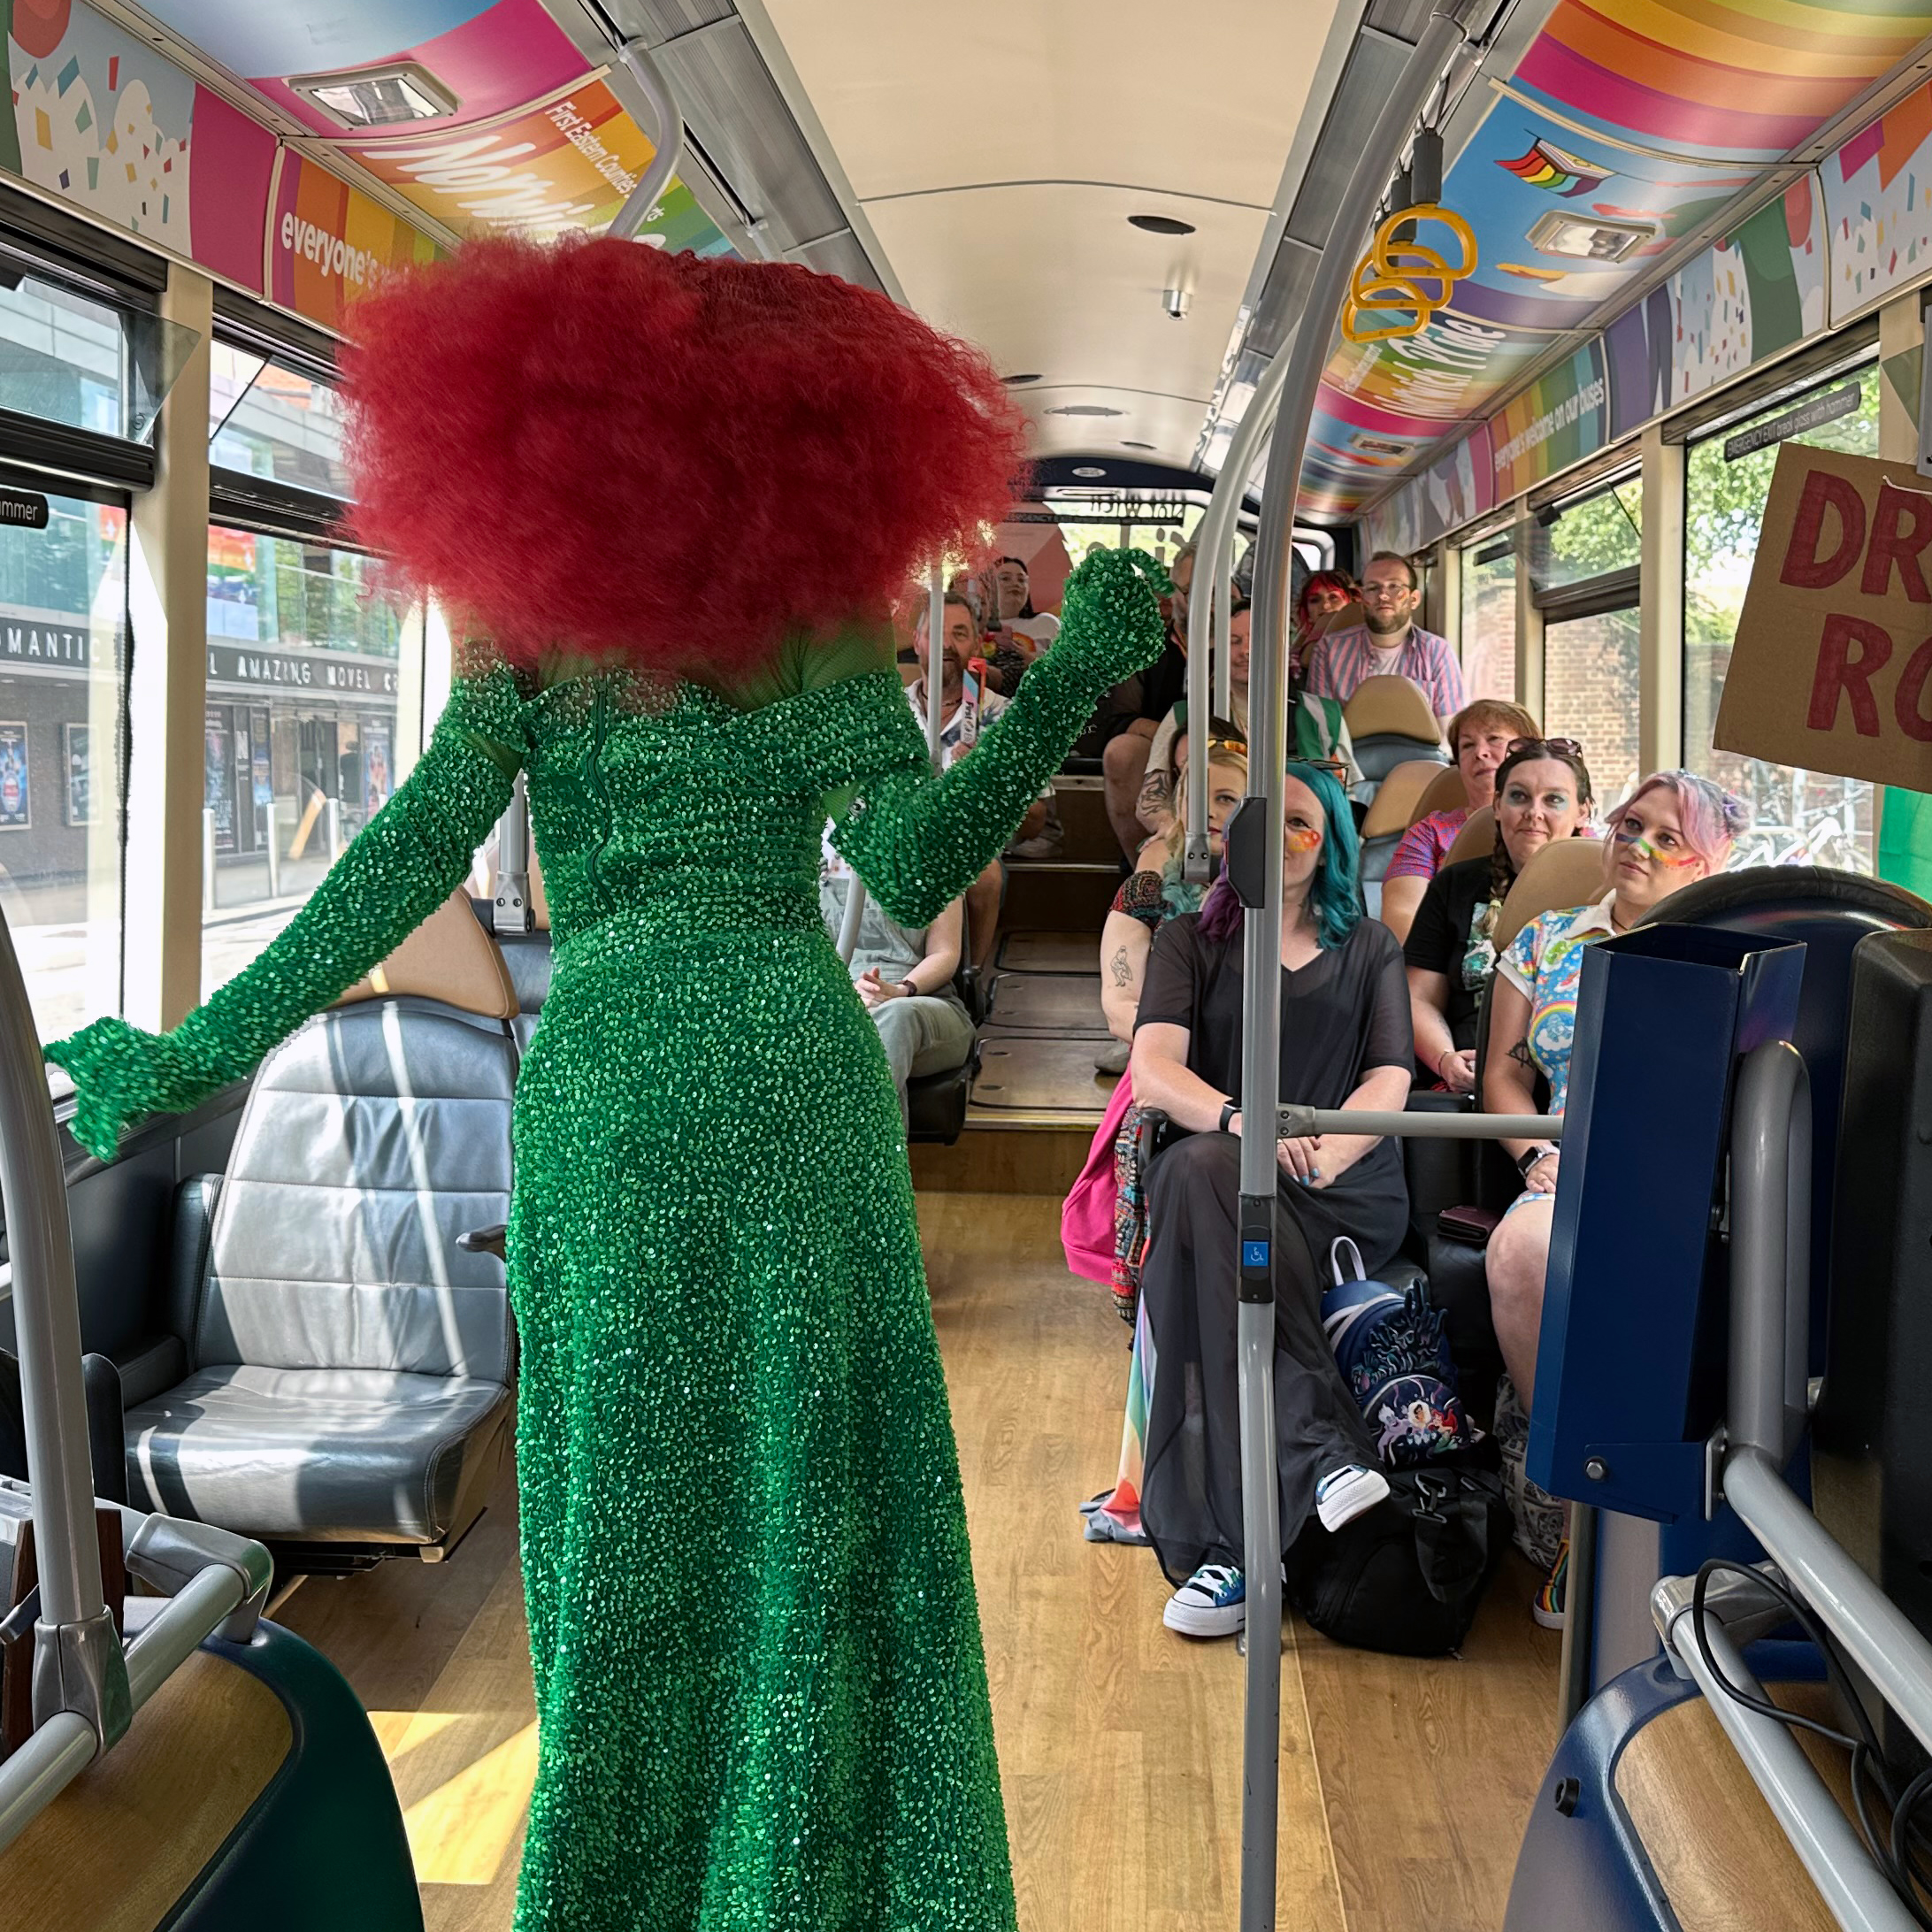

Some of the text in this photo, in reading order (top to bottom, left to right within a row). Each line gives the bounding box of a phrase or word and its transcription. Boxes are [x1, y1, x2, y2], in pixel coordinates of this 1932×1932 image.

[545, 101, 584, 131] First
[565, 122, 608, 163] Eastern
[281, 211, 379, 290] everyone's
[1388, 318, 1506, 371] Pride
[0, 500, 38, 521] mmer
[1779, 470, 1932, 603] DR
[0, 626, 101, 663] MANTIC
